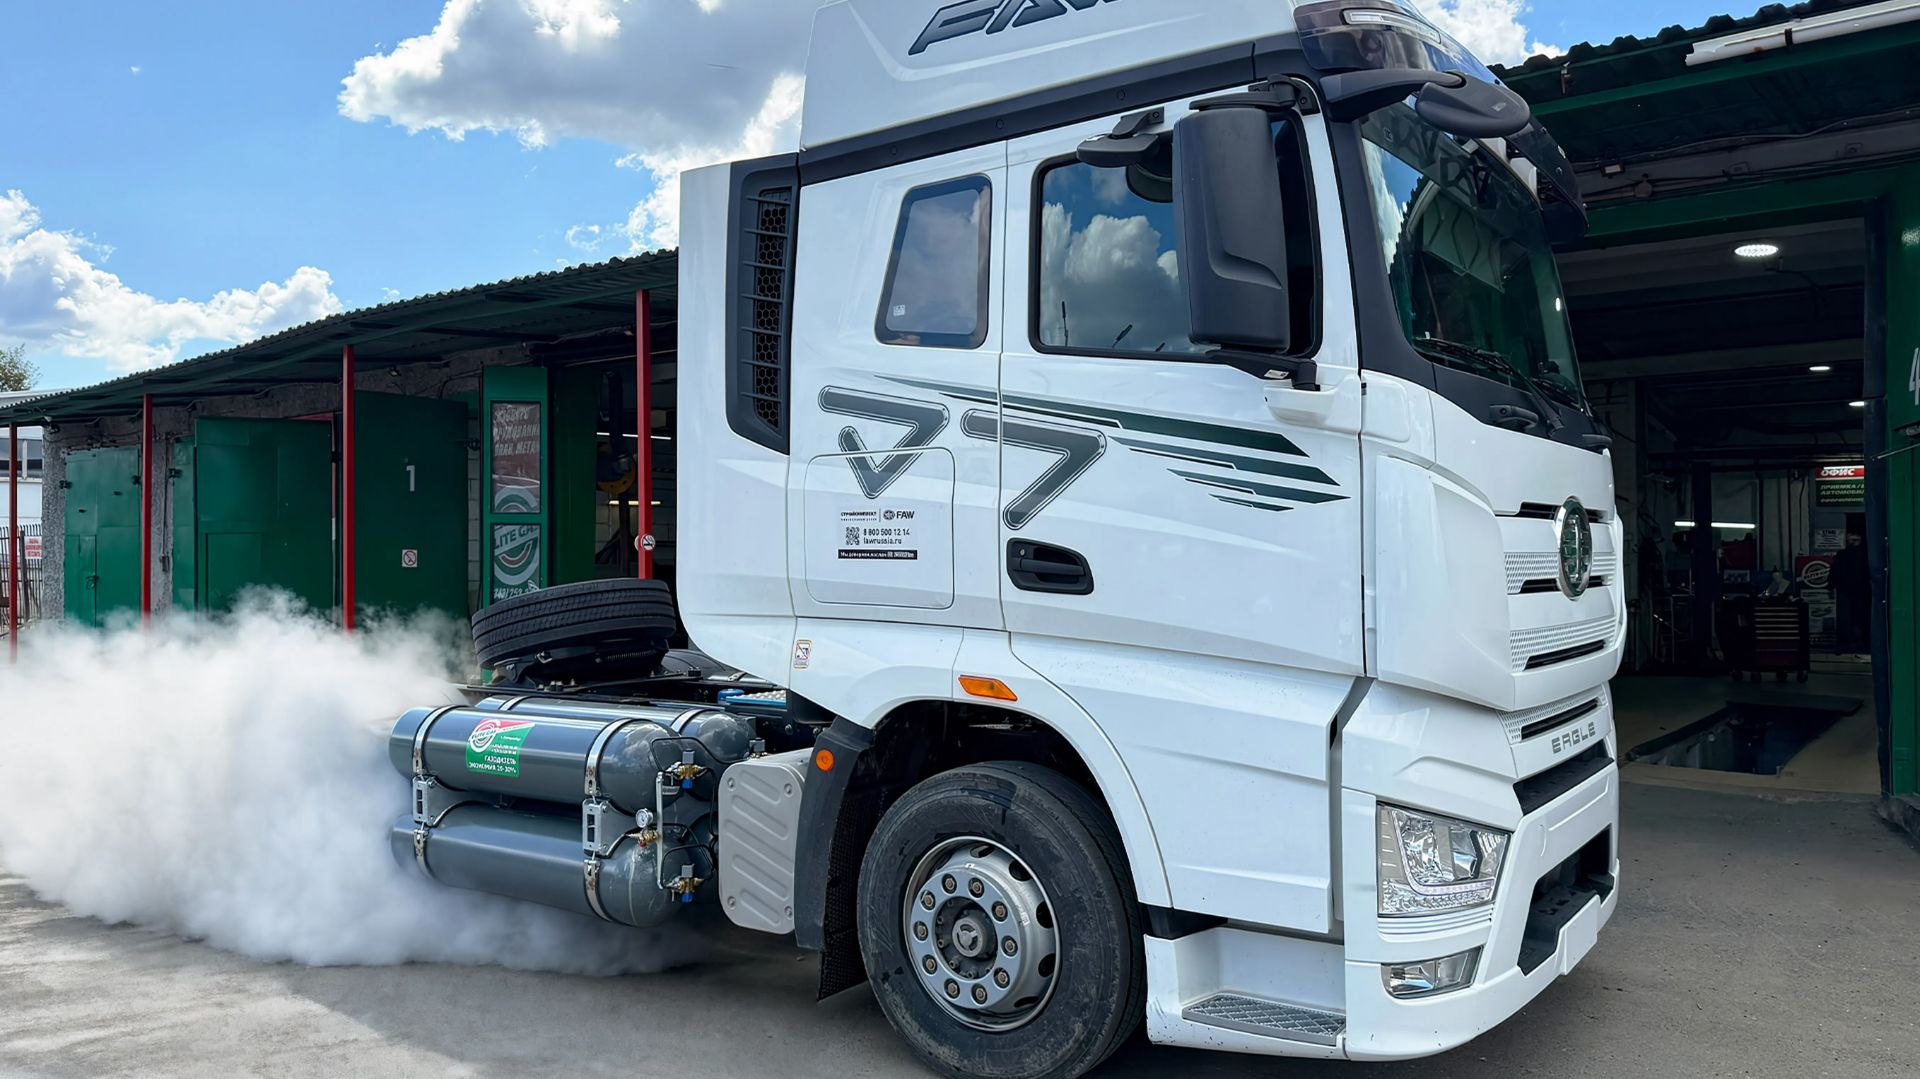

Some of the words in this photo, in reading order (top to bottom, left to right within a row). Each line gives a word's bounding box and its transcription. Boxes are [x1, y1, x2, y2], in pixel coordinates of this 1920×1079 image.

[908, 0, 1124, 55] FA
[406, 465, 415, 492] 1
[1821, 468, 1855, 477] ОФИС
[896, 510, 915, 519] FAW
[863, 528, 867, 536] 8
[868, 528, 880, 536] 800
[880, 528, 892, 536] 500
[893, 528, 901, 536] 12
[903, 528, 910, 536] 14
[1551, 721, 1596, 754] EAGLE
